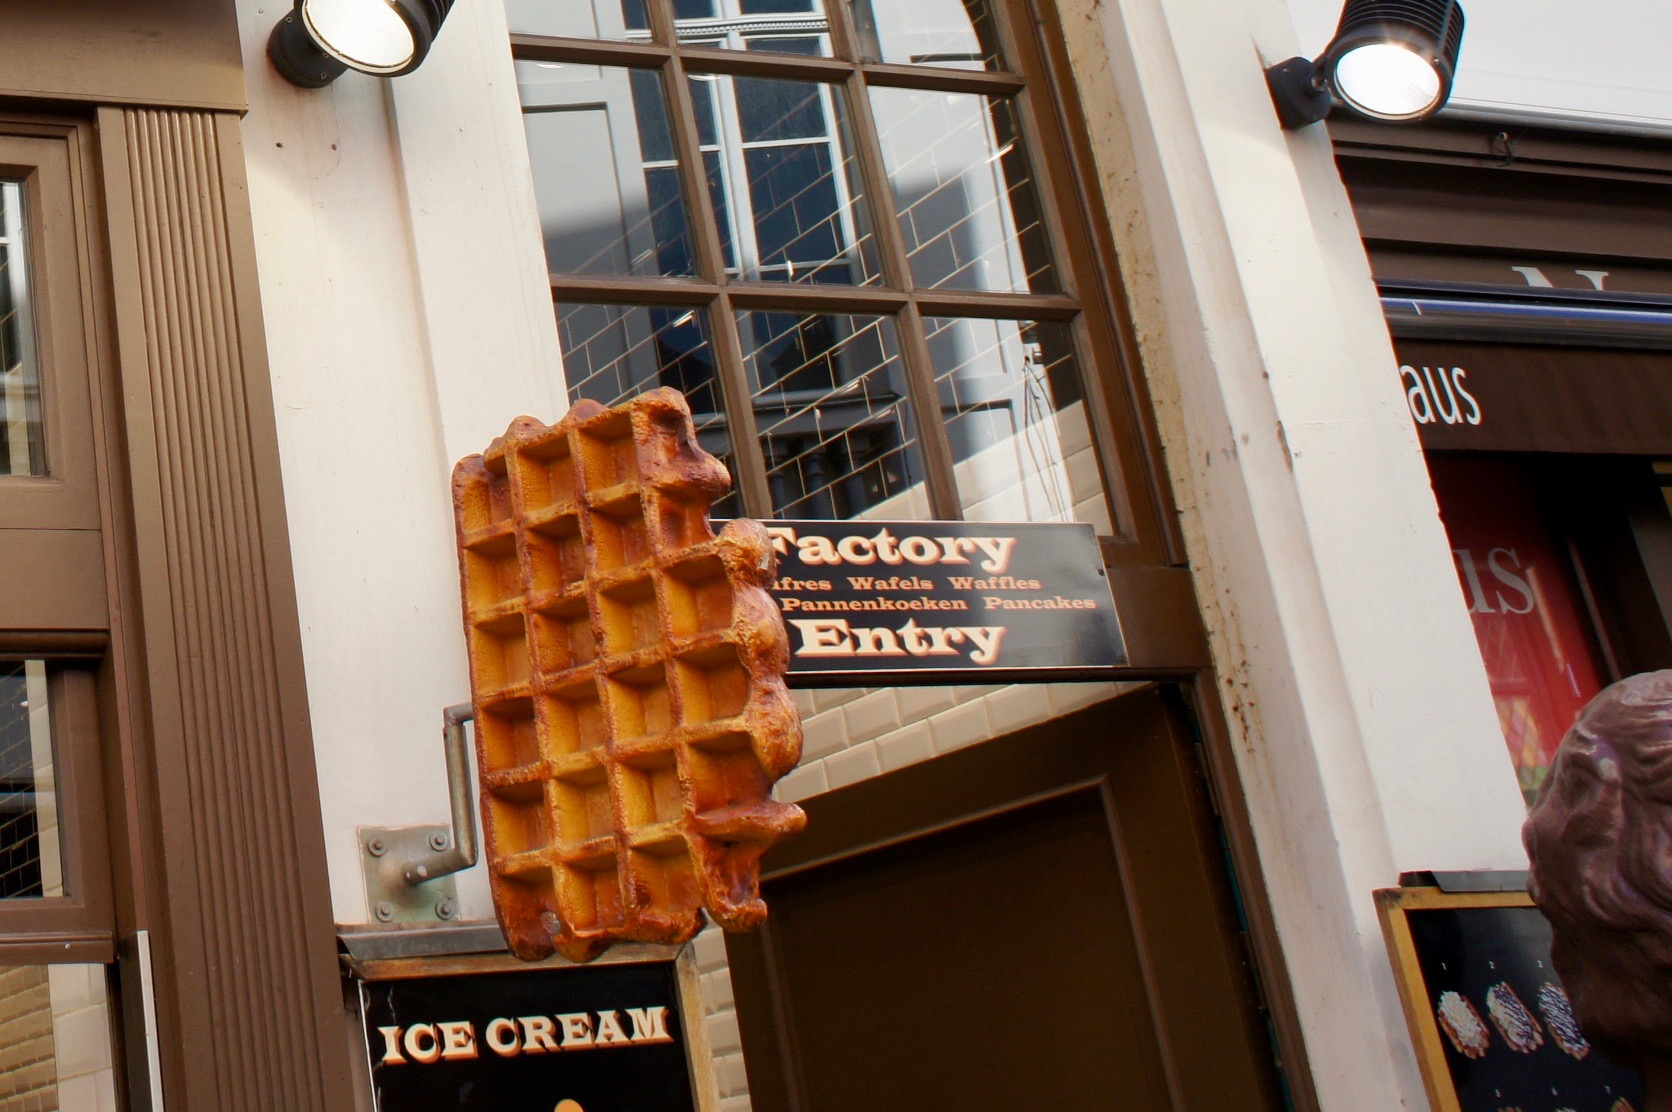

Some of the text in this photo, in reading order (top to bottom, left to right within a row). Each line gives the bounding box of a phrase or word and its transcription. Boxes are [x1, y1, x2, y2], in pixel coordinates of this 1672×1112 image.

[846, 576, 935, 592] Wafels
[946, 575, 1043, 592] Waffles
[779, 595, 1098, 613] Pannenkoeken Pancakes
[787, 616, 1008, 666] Entry
[378, 1004, 674, 1066] ICE CREAM
